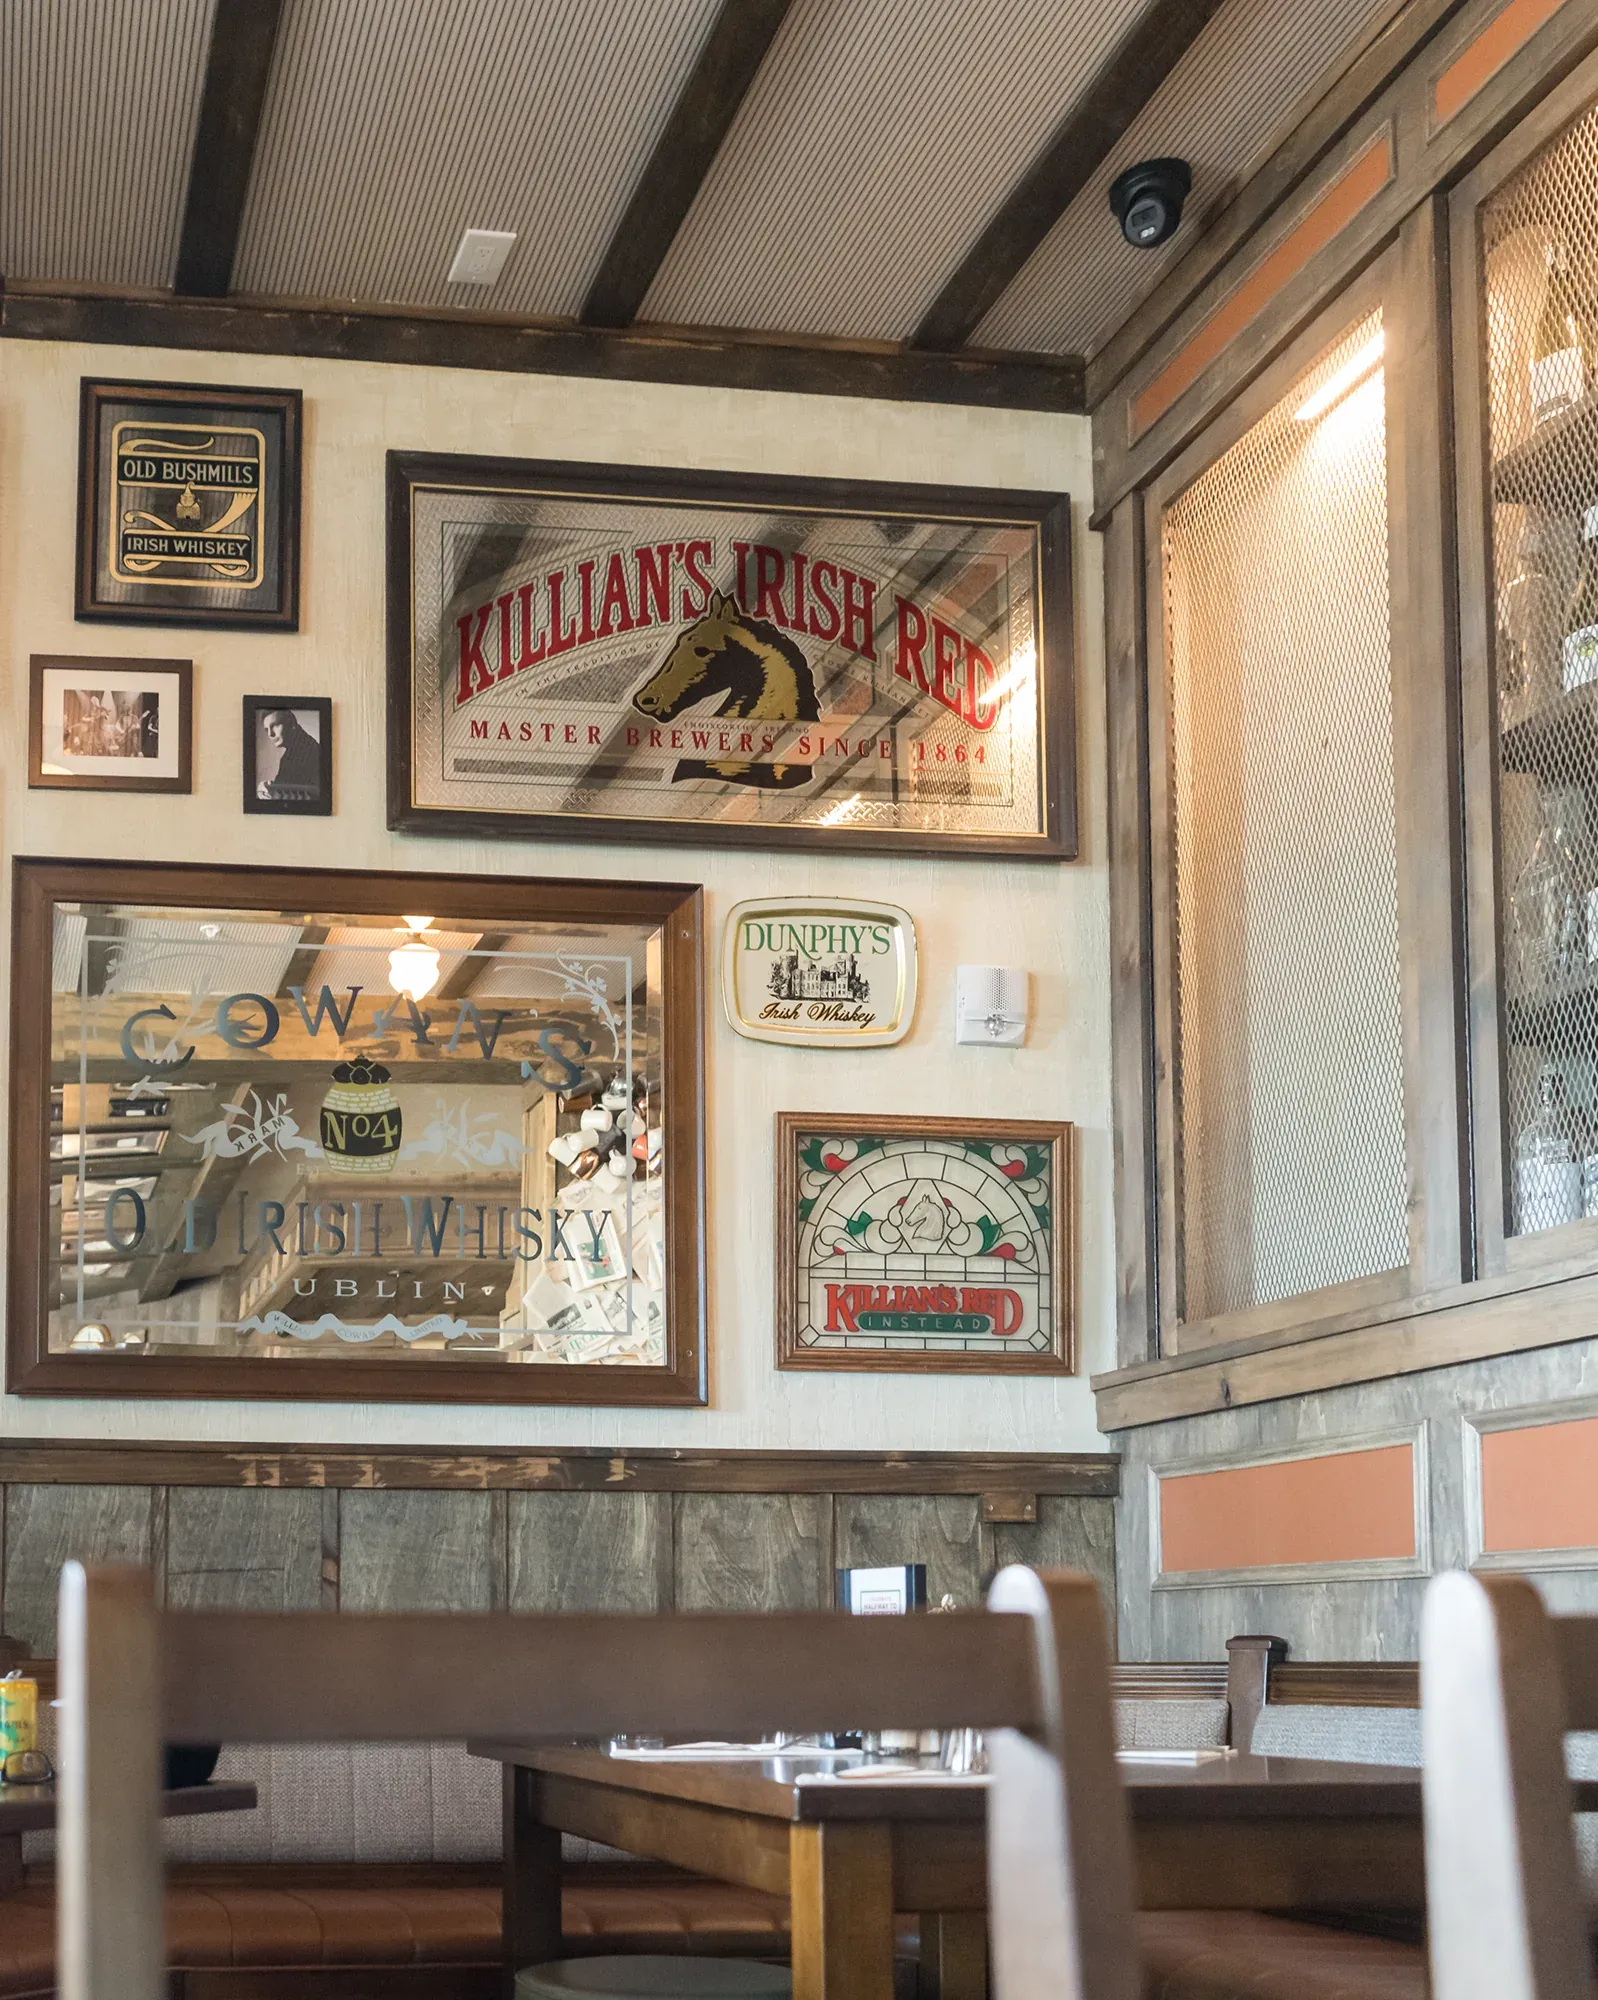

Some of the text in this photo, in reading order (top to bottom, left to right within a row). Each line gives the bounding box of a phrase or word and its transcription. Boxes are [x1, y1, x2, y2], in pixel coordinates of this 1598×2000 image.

[123, 460, 253, 484] OLD BUSHMILLS
[127, 537, 248, 557] IRISH WHISKEY
[456, 540, 999, 732] KILLIAN'S IRISH RED
[566, 646, 638, 674] TRADITION
[469, 719, 987, 765] MASTER BREWERS SINCE 1864
[743, 922, 892, 962] DUNPHY'S
[759, 1001, 877, 1029] Irish Whiskey
[104, 1187, 612, 1263] OD IRISH WHISKY
[823, 1283, 1024, 1336] KILLIAN'S RED
[867, 1315, 982, 1330] INSTEAD
[272, 1314, 443, 1341] WILLIAM COWAN LIMITED
